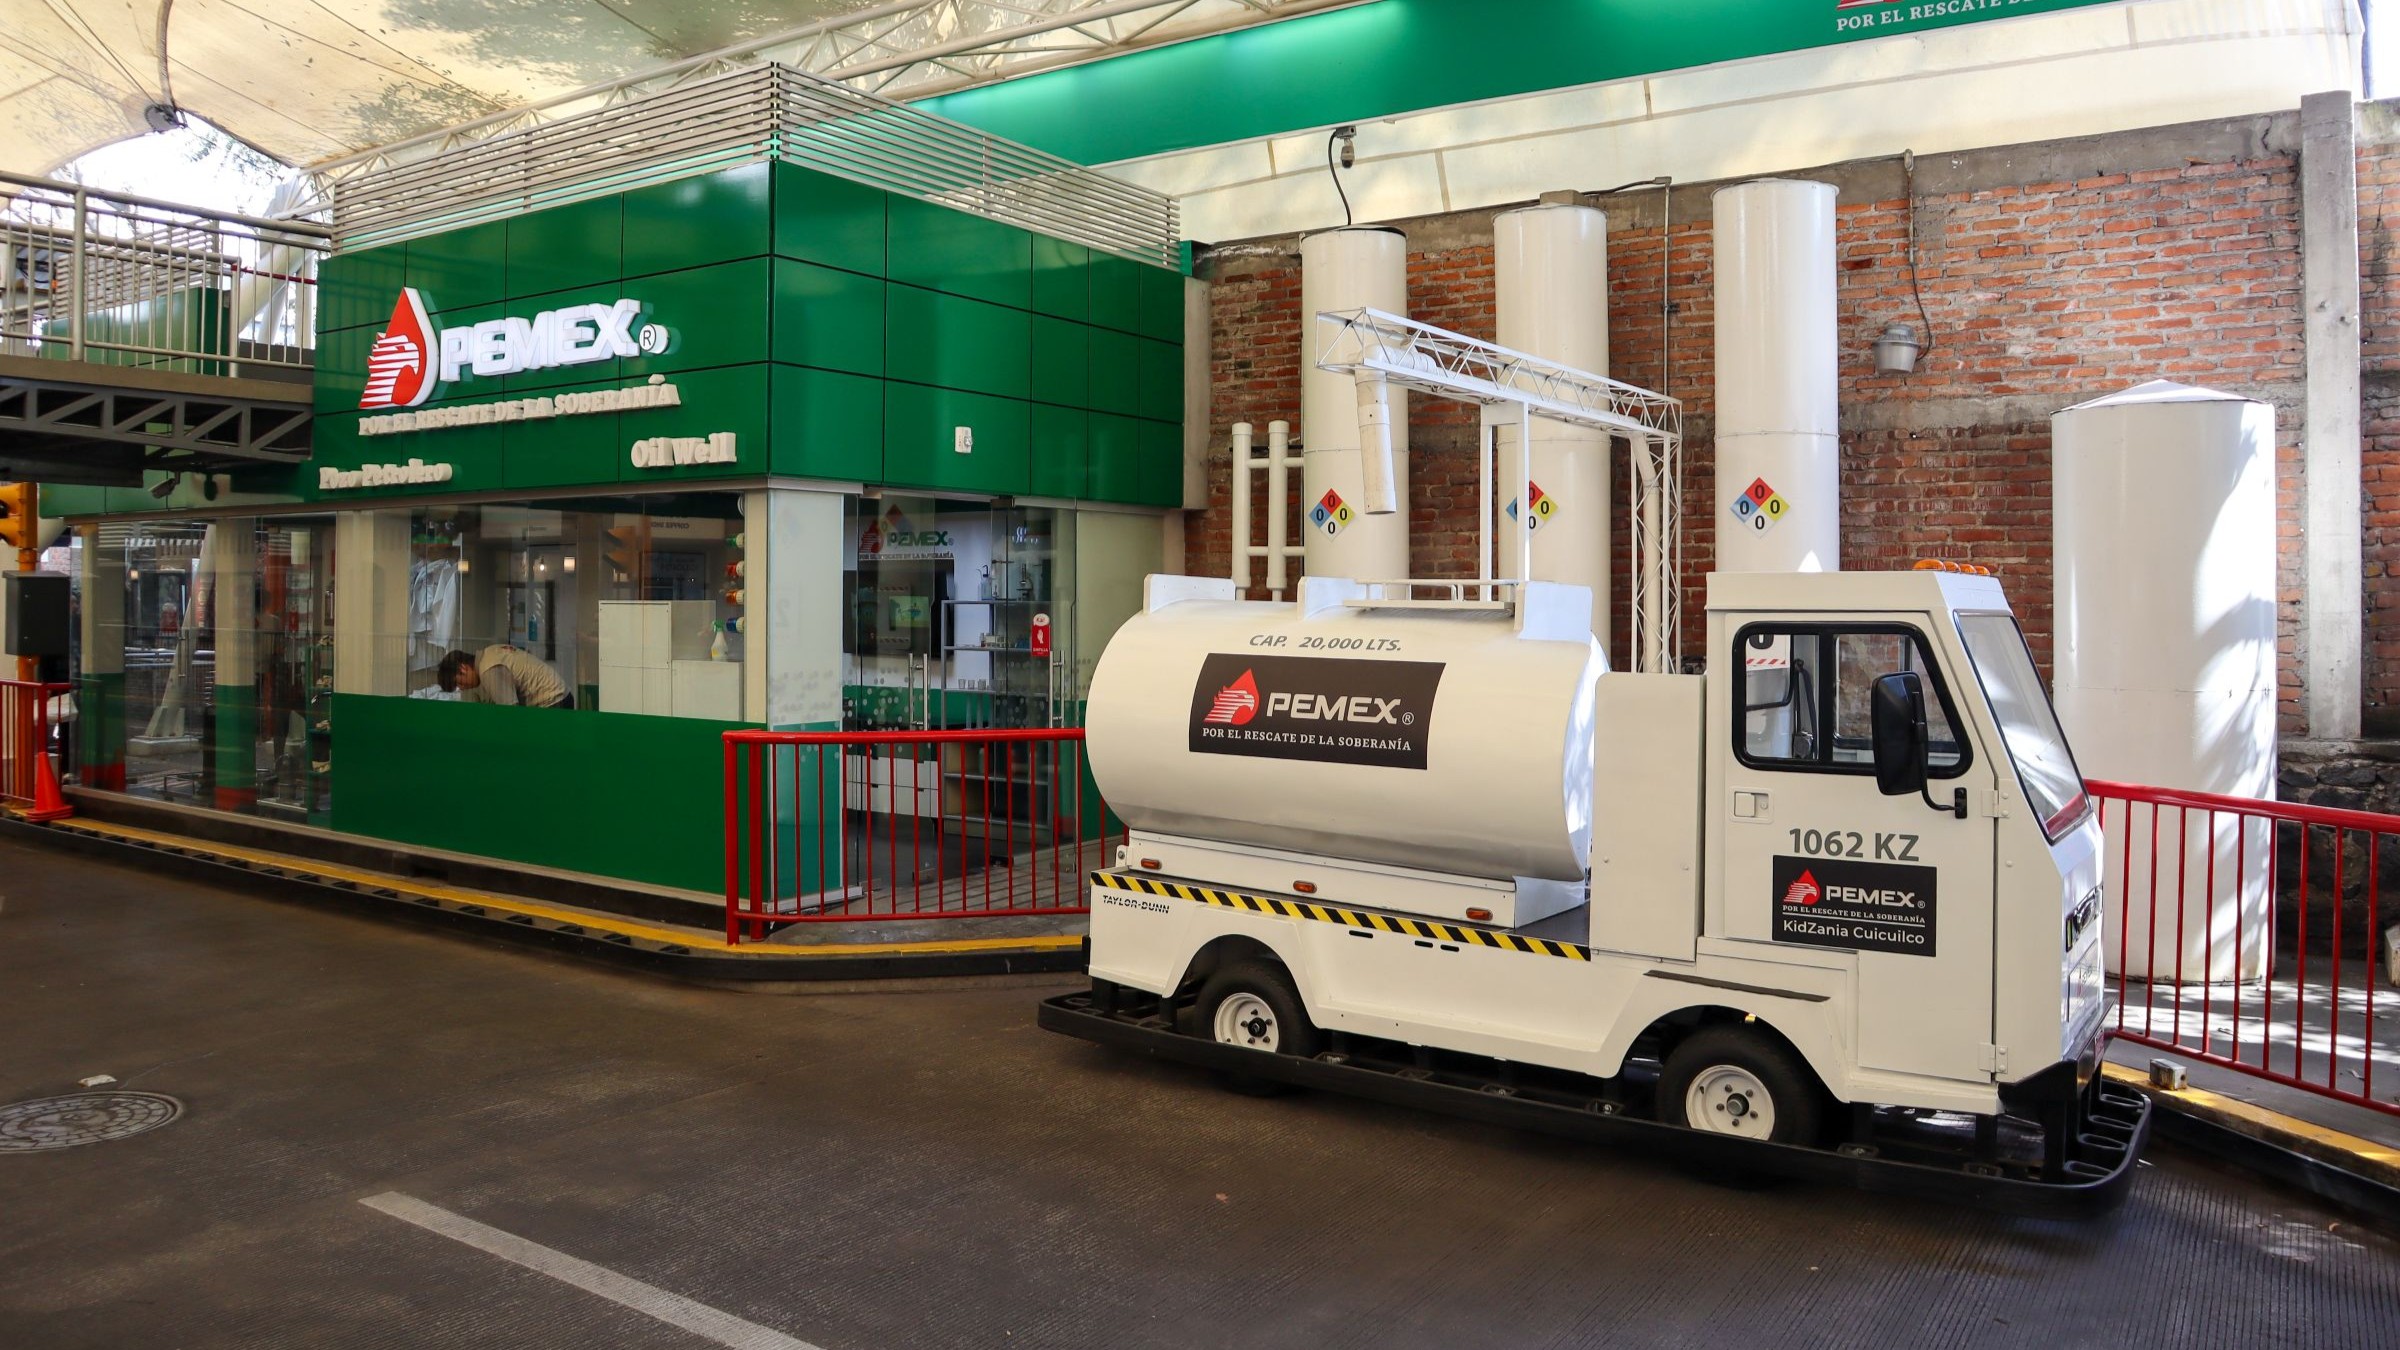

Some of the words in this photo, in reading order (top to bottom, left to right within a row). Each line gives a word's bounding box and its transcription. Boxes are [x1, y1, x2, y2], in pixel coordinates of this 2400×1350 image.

[1836, 13, 1875, 31] POR
[1880, 9, 1904, 25] EL
[440, 298, 641, 382] PEMEX
[358, 414, 394, 436] POR
[415, 403, 495, 429] RESCATE
[494, 399, 524, 422] DE
[522, 397, 556, 419] LA
[554, 373, 682, 415] SOBERANÍA
[631, 437, 675, 468] Oil
[672, 432, 737, 465] Well
[319, 466, 363, 490] Pozo
[1328, 494, 1336, 508] 0
[1755, 484, 1765, 500] 0
[1316, 508, 1324, 522] 0
[1340, 508, 1348, 521] 0
[1541, 500, 1549, 514] 0
[1740, 500, 1750, 515] 0
[1770, 499, 1780, 514] 0
[1328, 521, 1336, 535] 0
[1755, 515, 1765, 530] 0
[887, 531, 948, 547] PEMEX
[1249, 634, 1288, 647] CAP.
[1298, 636, 1364, 650] 20,000
[1365, 638, 1402, 651] LTS.
[1266, 692, 1401, 725] PEMEX
[1202, 727, 1225, 738] POR
[1227, 729, 1242, 740] EL
[1244, 730, 1297, 744] RESCATE
[1299, 734, 1316, 745] DE
[1318, 735, 1335, 746] LA
[1338, 736, 1412, 751] SOBERANÍA
[1789, 828, 1864, 858] 1062
[1875, 832, 1920, 862] KZ
[1103, 894, 1170, 914] TAYLOR-DUNN
[1825, 885, 1915, 908] PEMEX
[1782, 904, 1799, 912] POR
[1812, 907, 1849, 917] RESCATE
[1876, 913, 1926, 924] SOBERANÍA
[1783, 919, 1849, 937] KidZania
[1853, 926, 1925, 944] Cuicuilco
